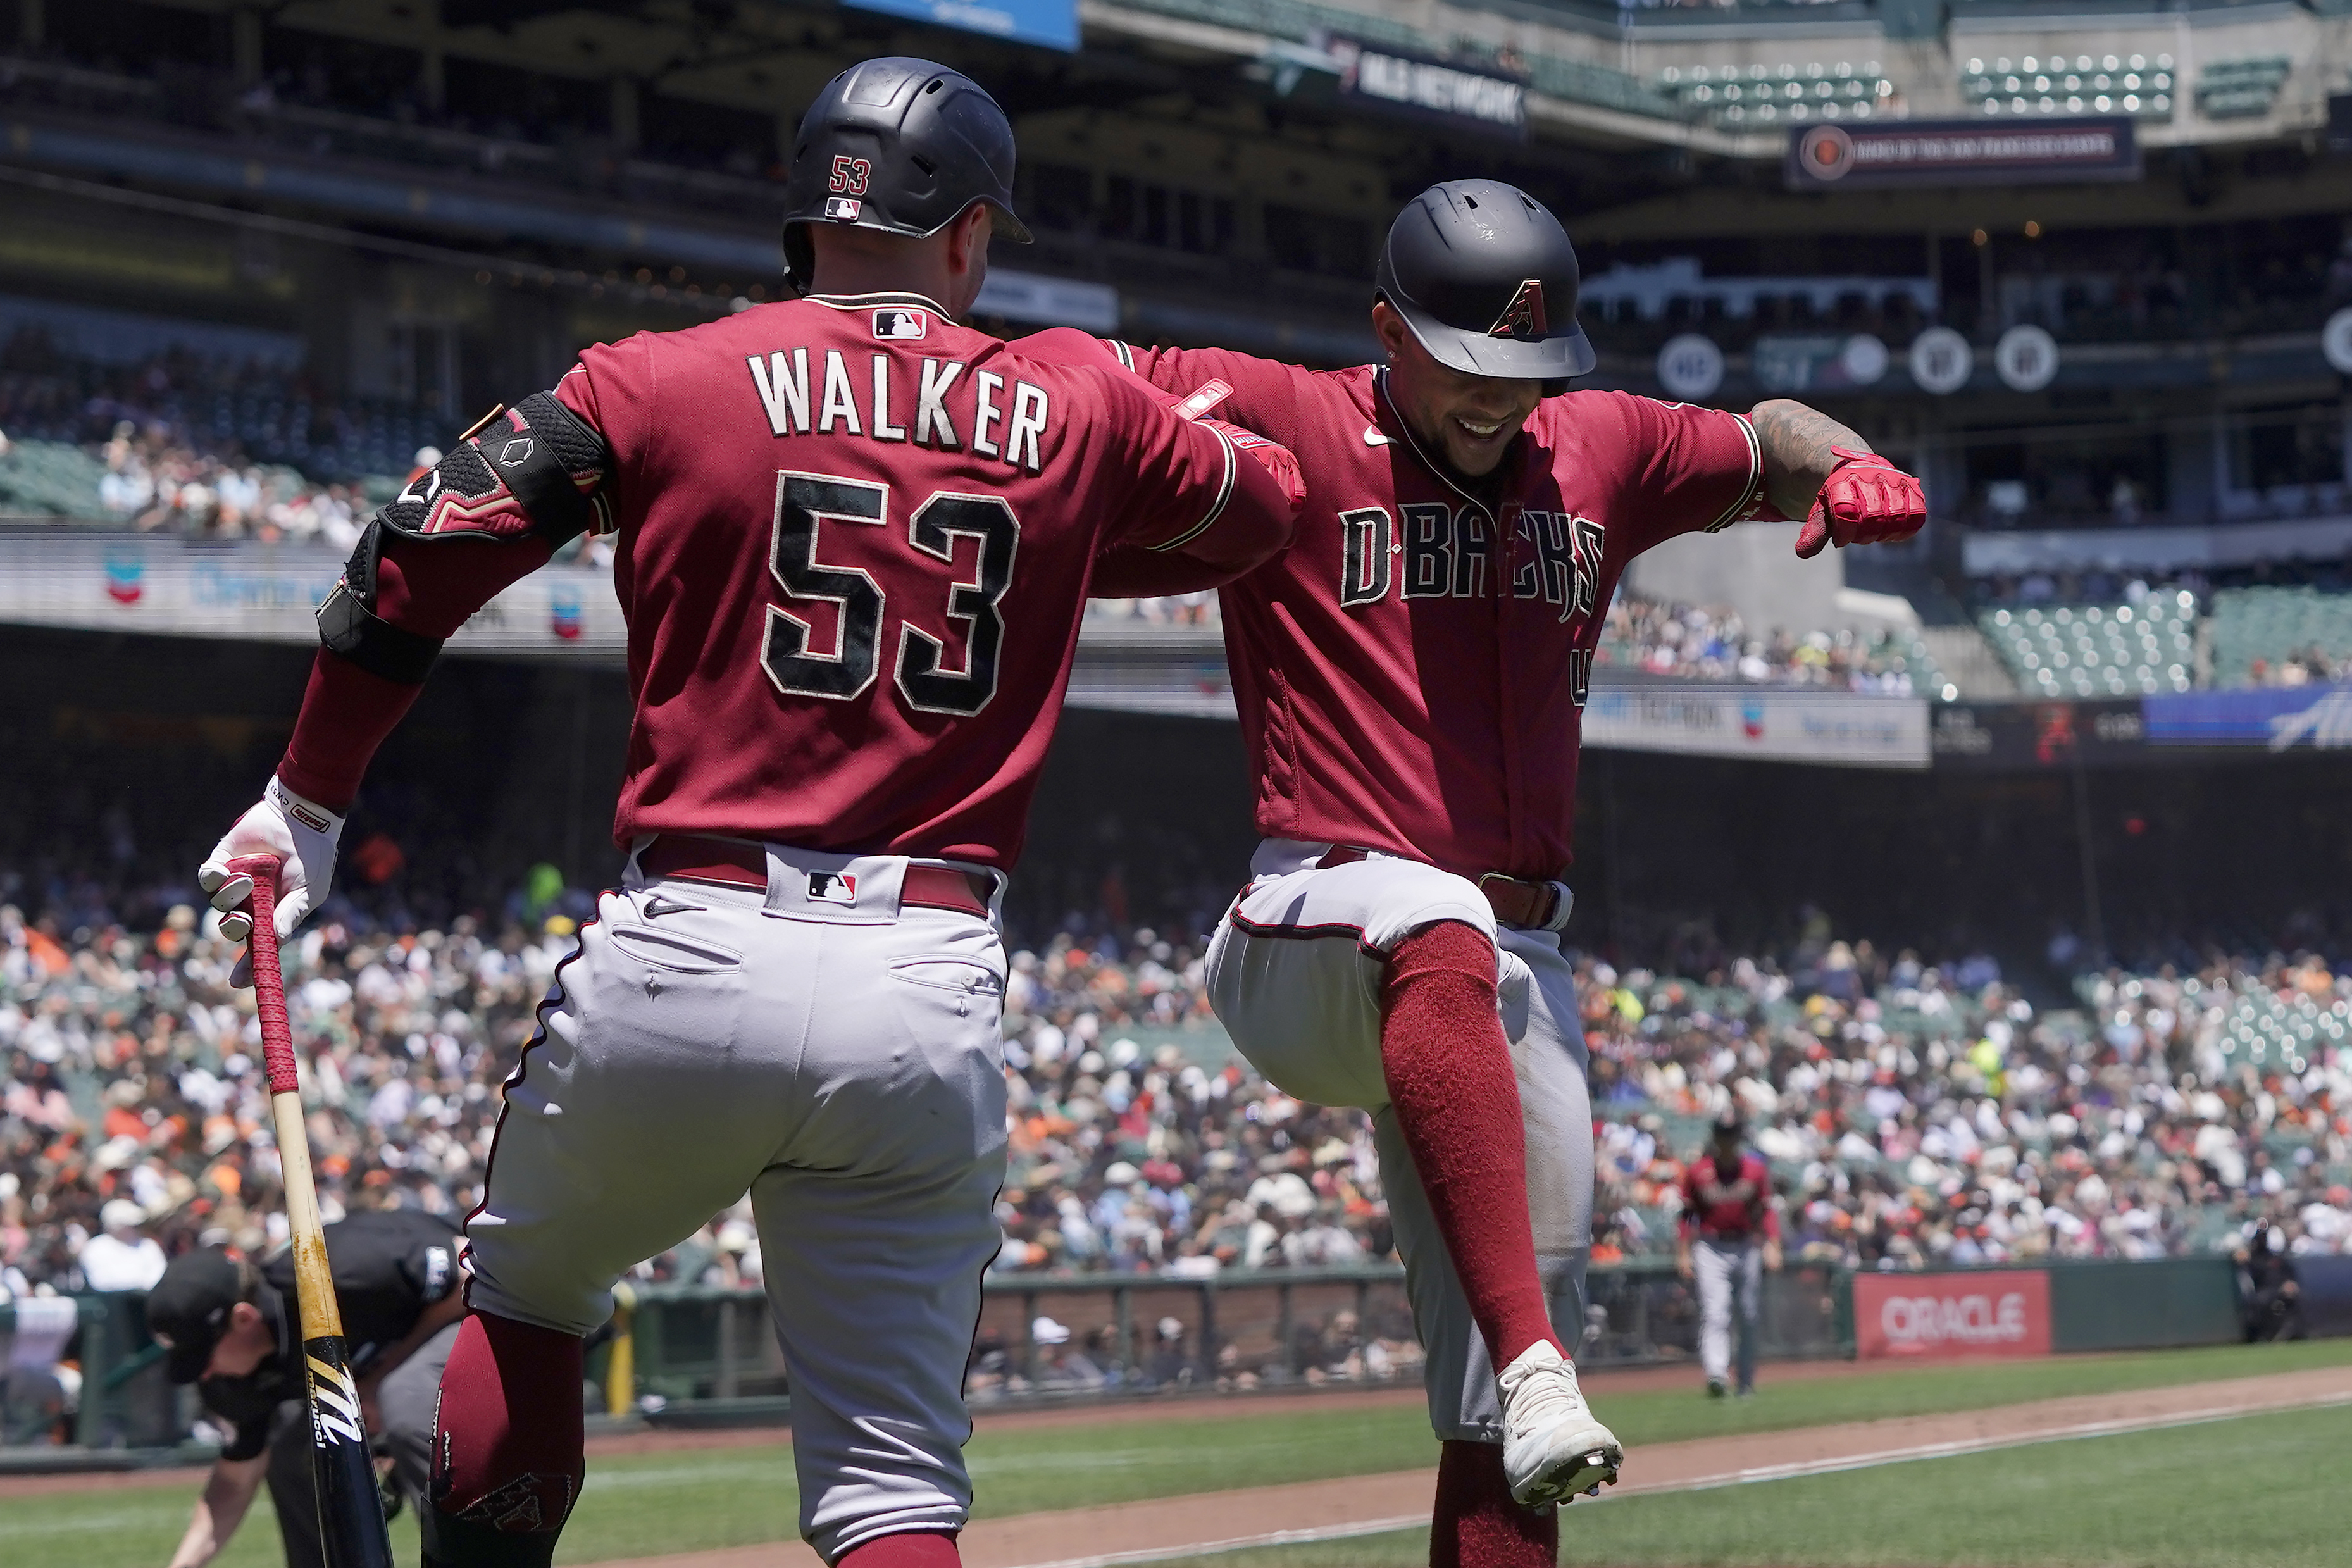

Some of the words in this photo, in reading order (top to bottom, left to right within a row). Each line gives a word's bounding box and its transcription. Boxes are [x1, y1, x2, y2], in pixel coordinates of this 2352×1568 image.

[829, 154, 871, 196] 53
[745, 346, 1049, 475] WALKER
[760, 469, 1021, 718] 53
[294, 807, 328, 831] Franklin
[1881, 1293, 2027, 1343] ORACLE
[308, 1371, 327, 1449] marucci
